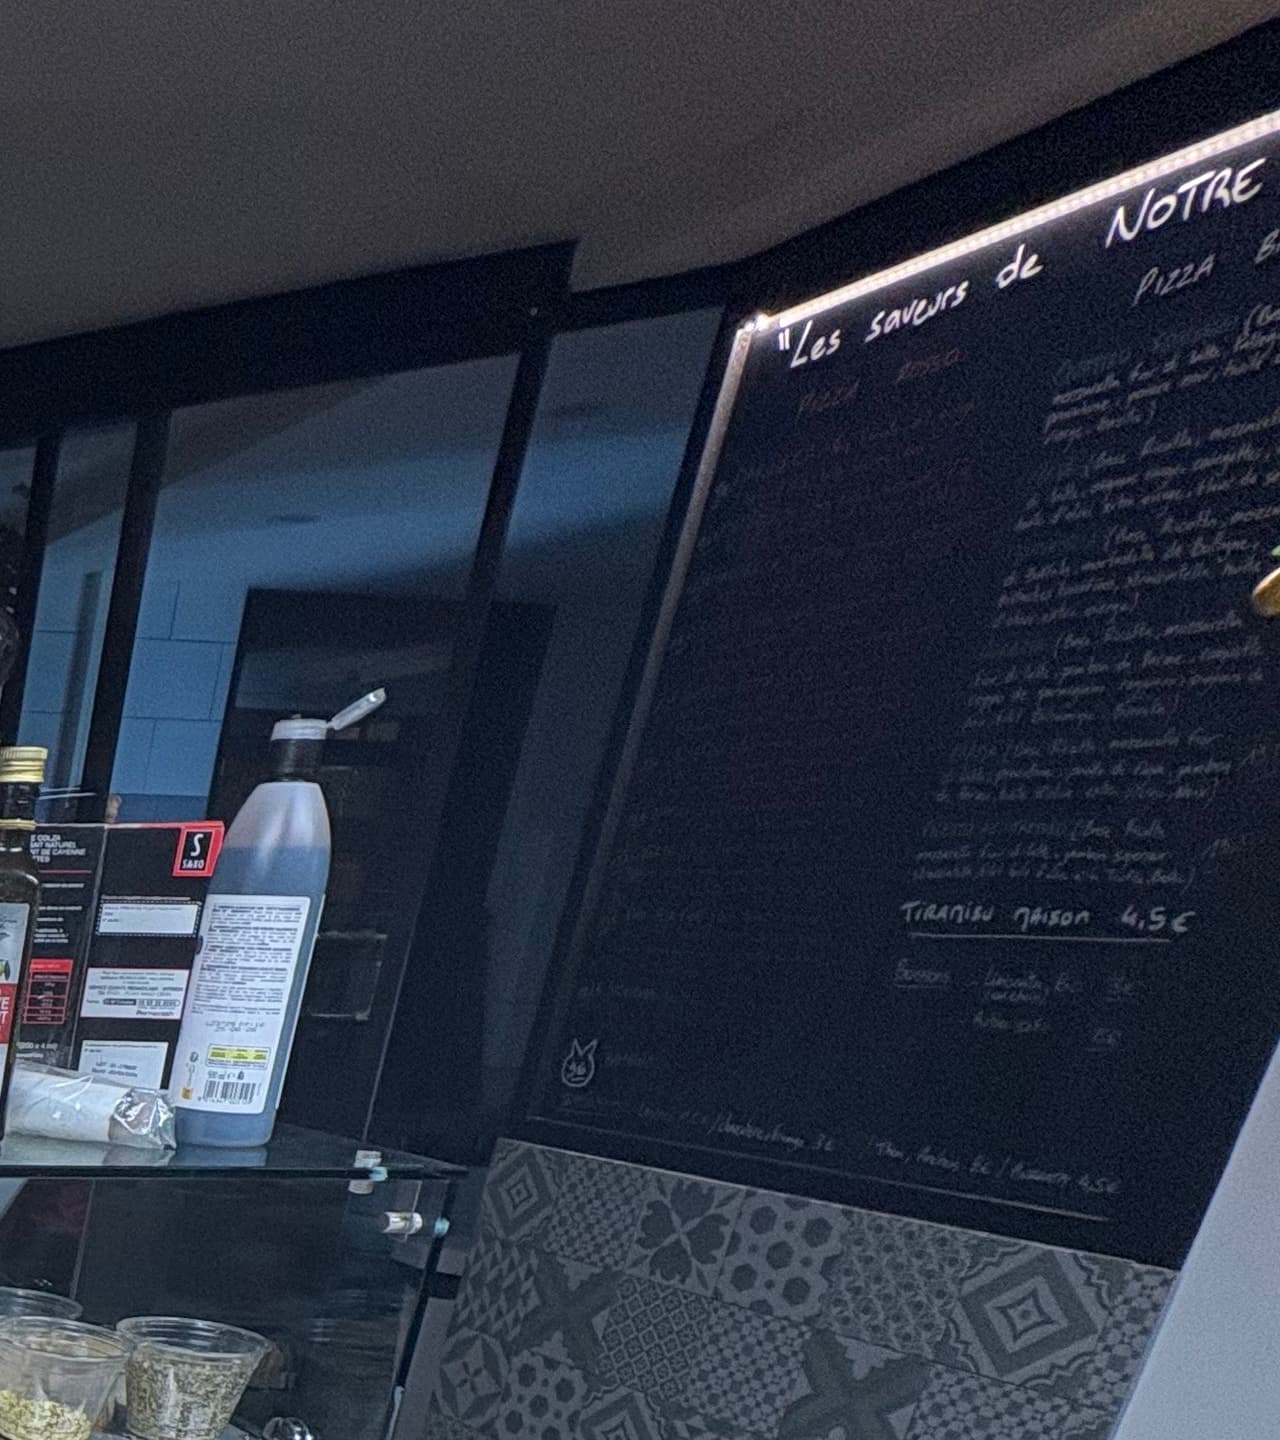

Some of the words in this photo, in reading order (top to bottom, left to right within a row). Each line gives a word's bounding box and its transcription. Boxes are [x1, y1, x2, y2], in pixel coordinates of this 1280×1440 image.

[865, 280, 969, 342] saveurs
[996, 244, 1043, 288] de
[1104, 158, 1266, 248] NOTRE
[1132, 253, 1216, 306] PIZZA
